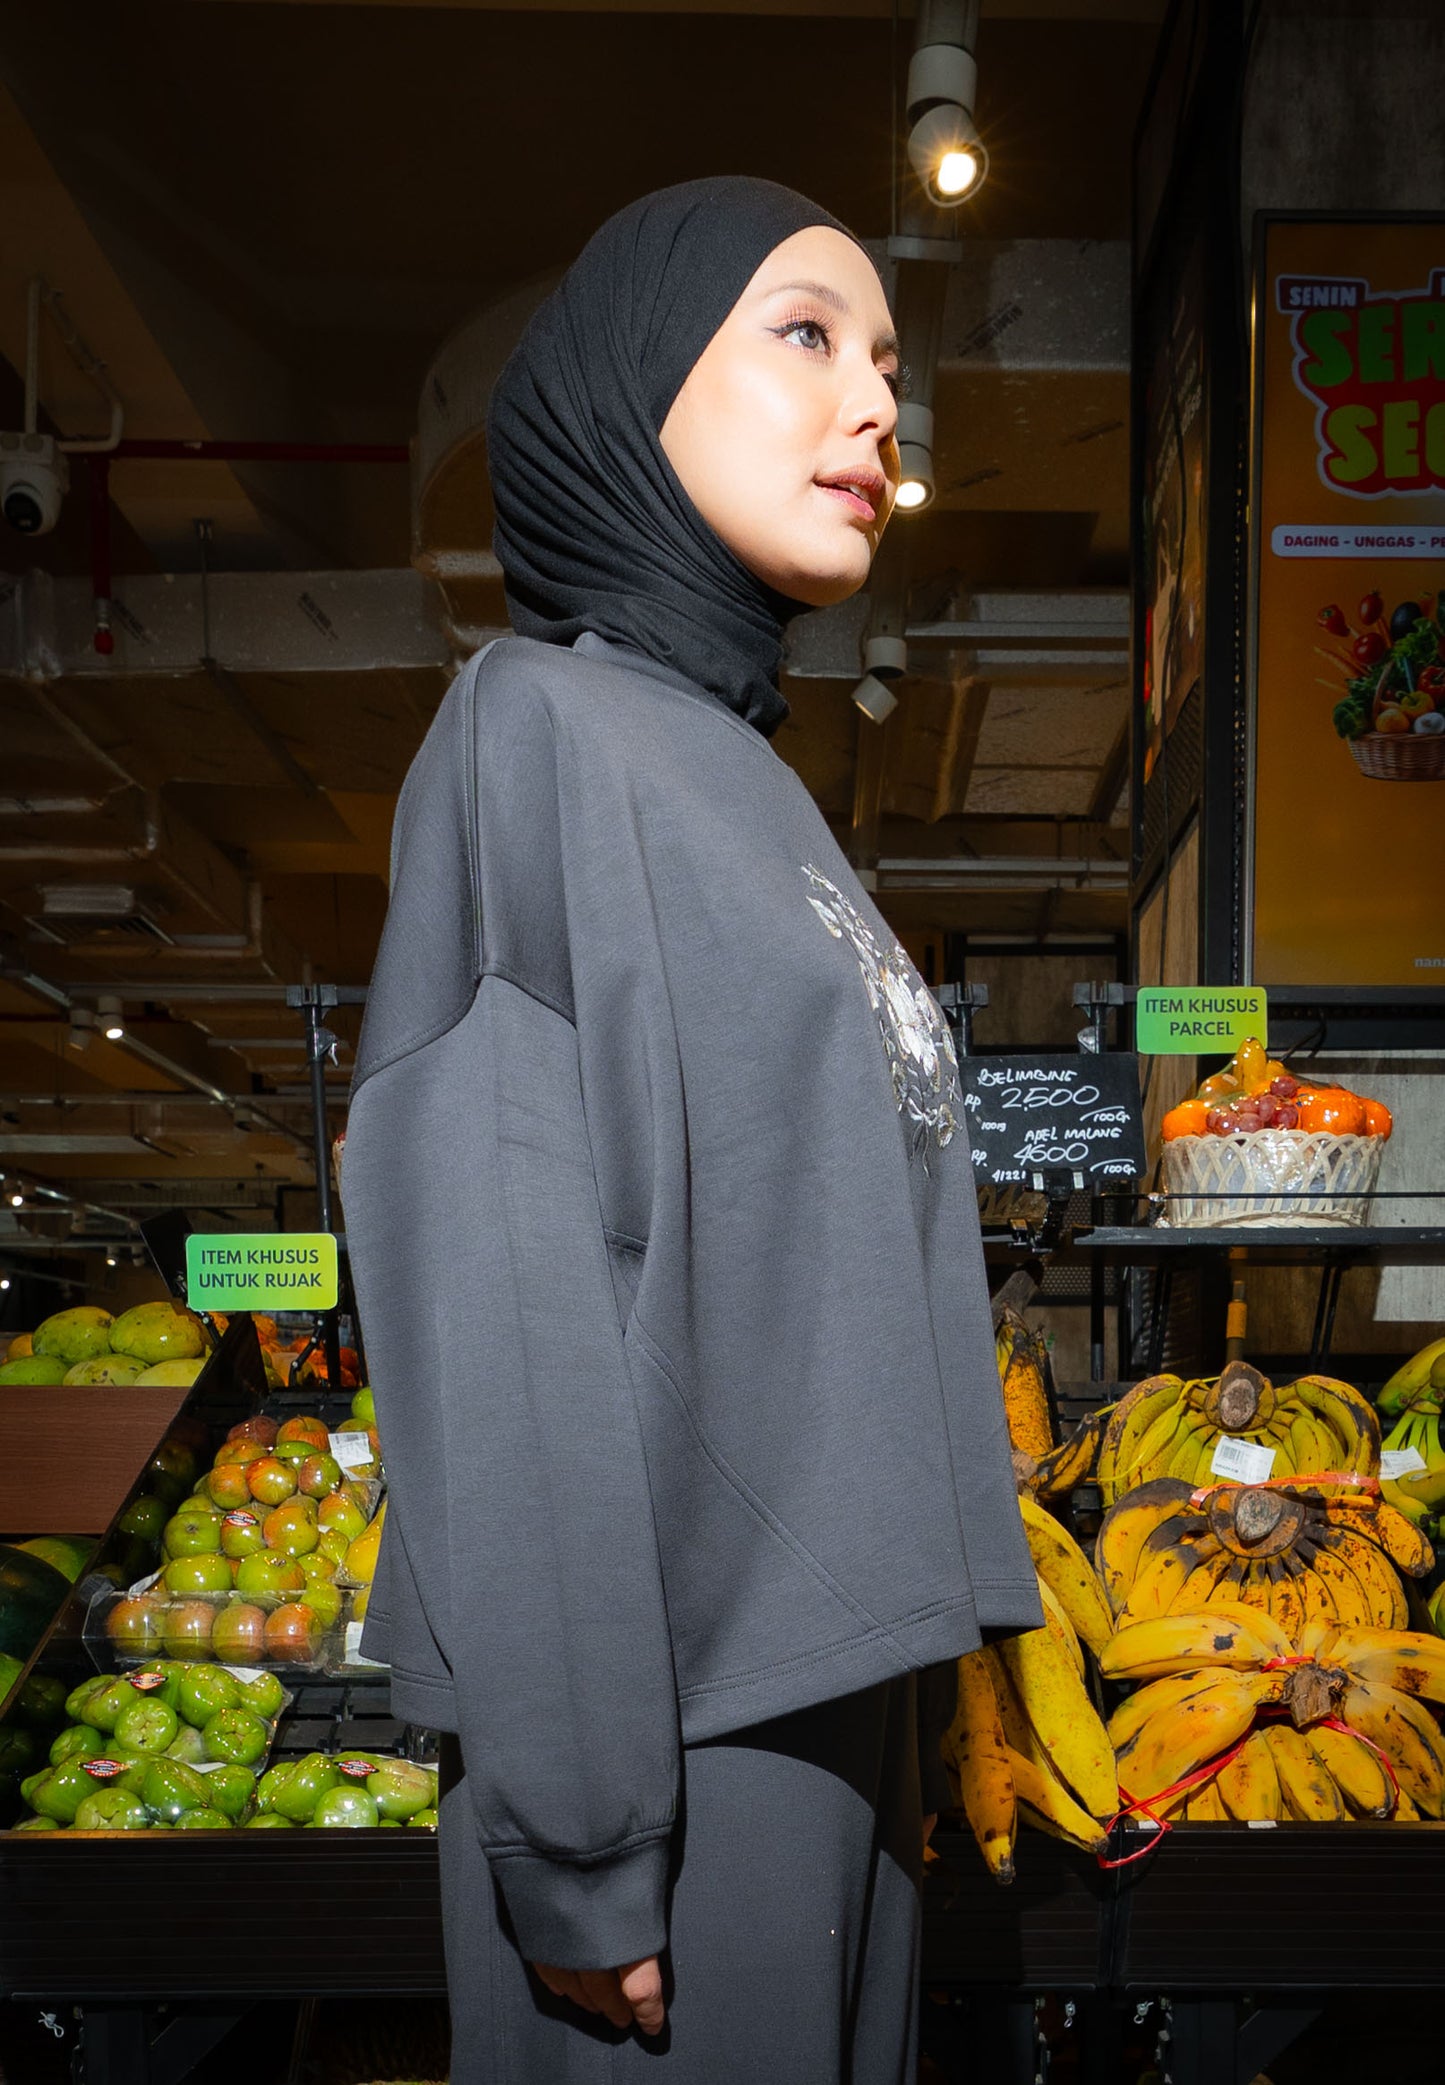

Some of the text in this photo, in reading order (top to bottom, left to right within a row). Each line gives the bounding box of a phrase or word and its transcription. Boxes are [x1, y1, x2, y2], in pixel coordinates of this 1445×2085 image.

[1288, 285, 1358, 307] SENIN
[1283, 535, 1340, 548] DAGING
[1354, 536, 1416, 548] UNGGAS
[1145, 998, 1259, 1013] ITEM KHUSUS
[1169, 1021, 1234, 1036] PARCEL
[1024, 1127, 1059, 1144] APEL
[201, 1249, 319, 1265] ITEM KHUSUS
[199, 1272, 322, 1288] UNTUK RUJAK
